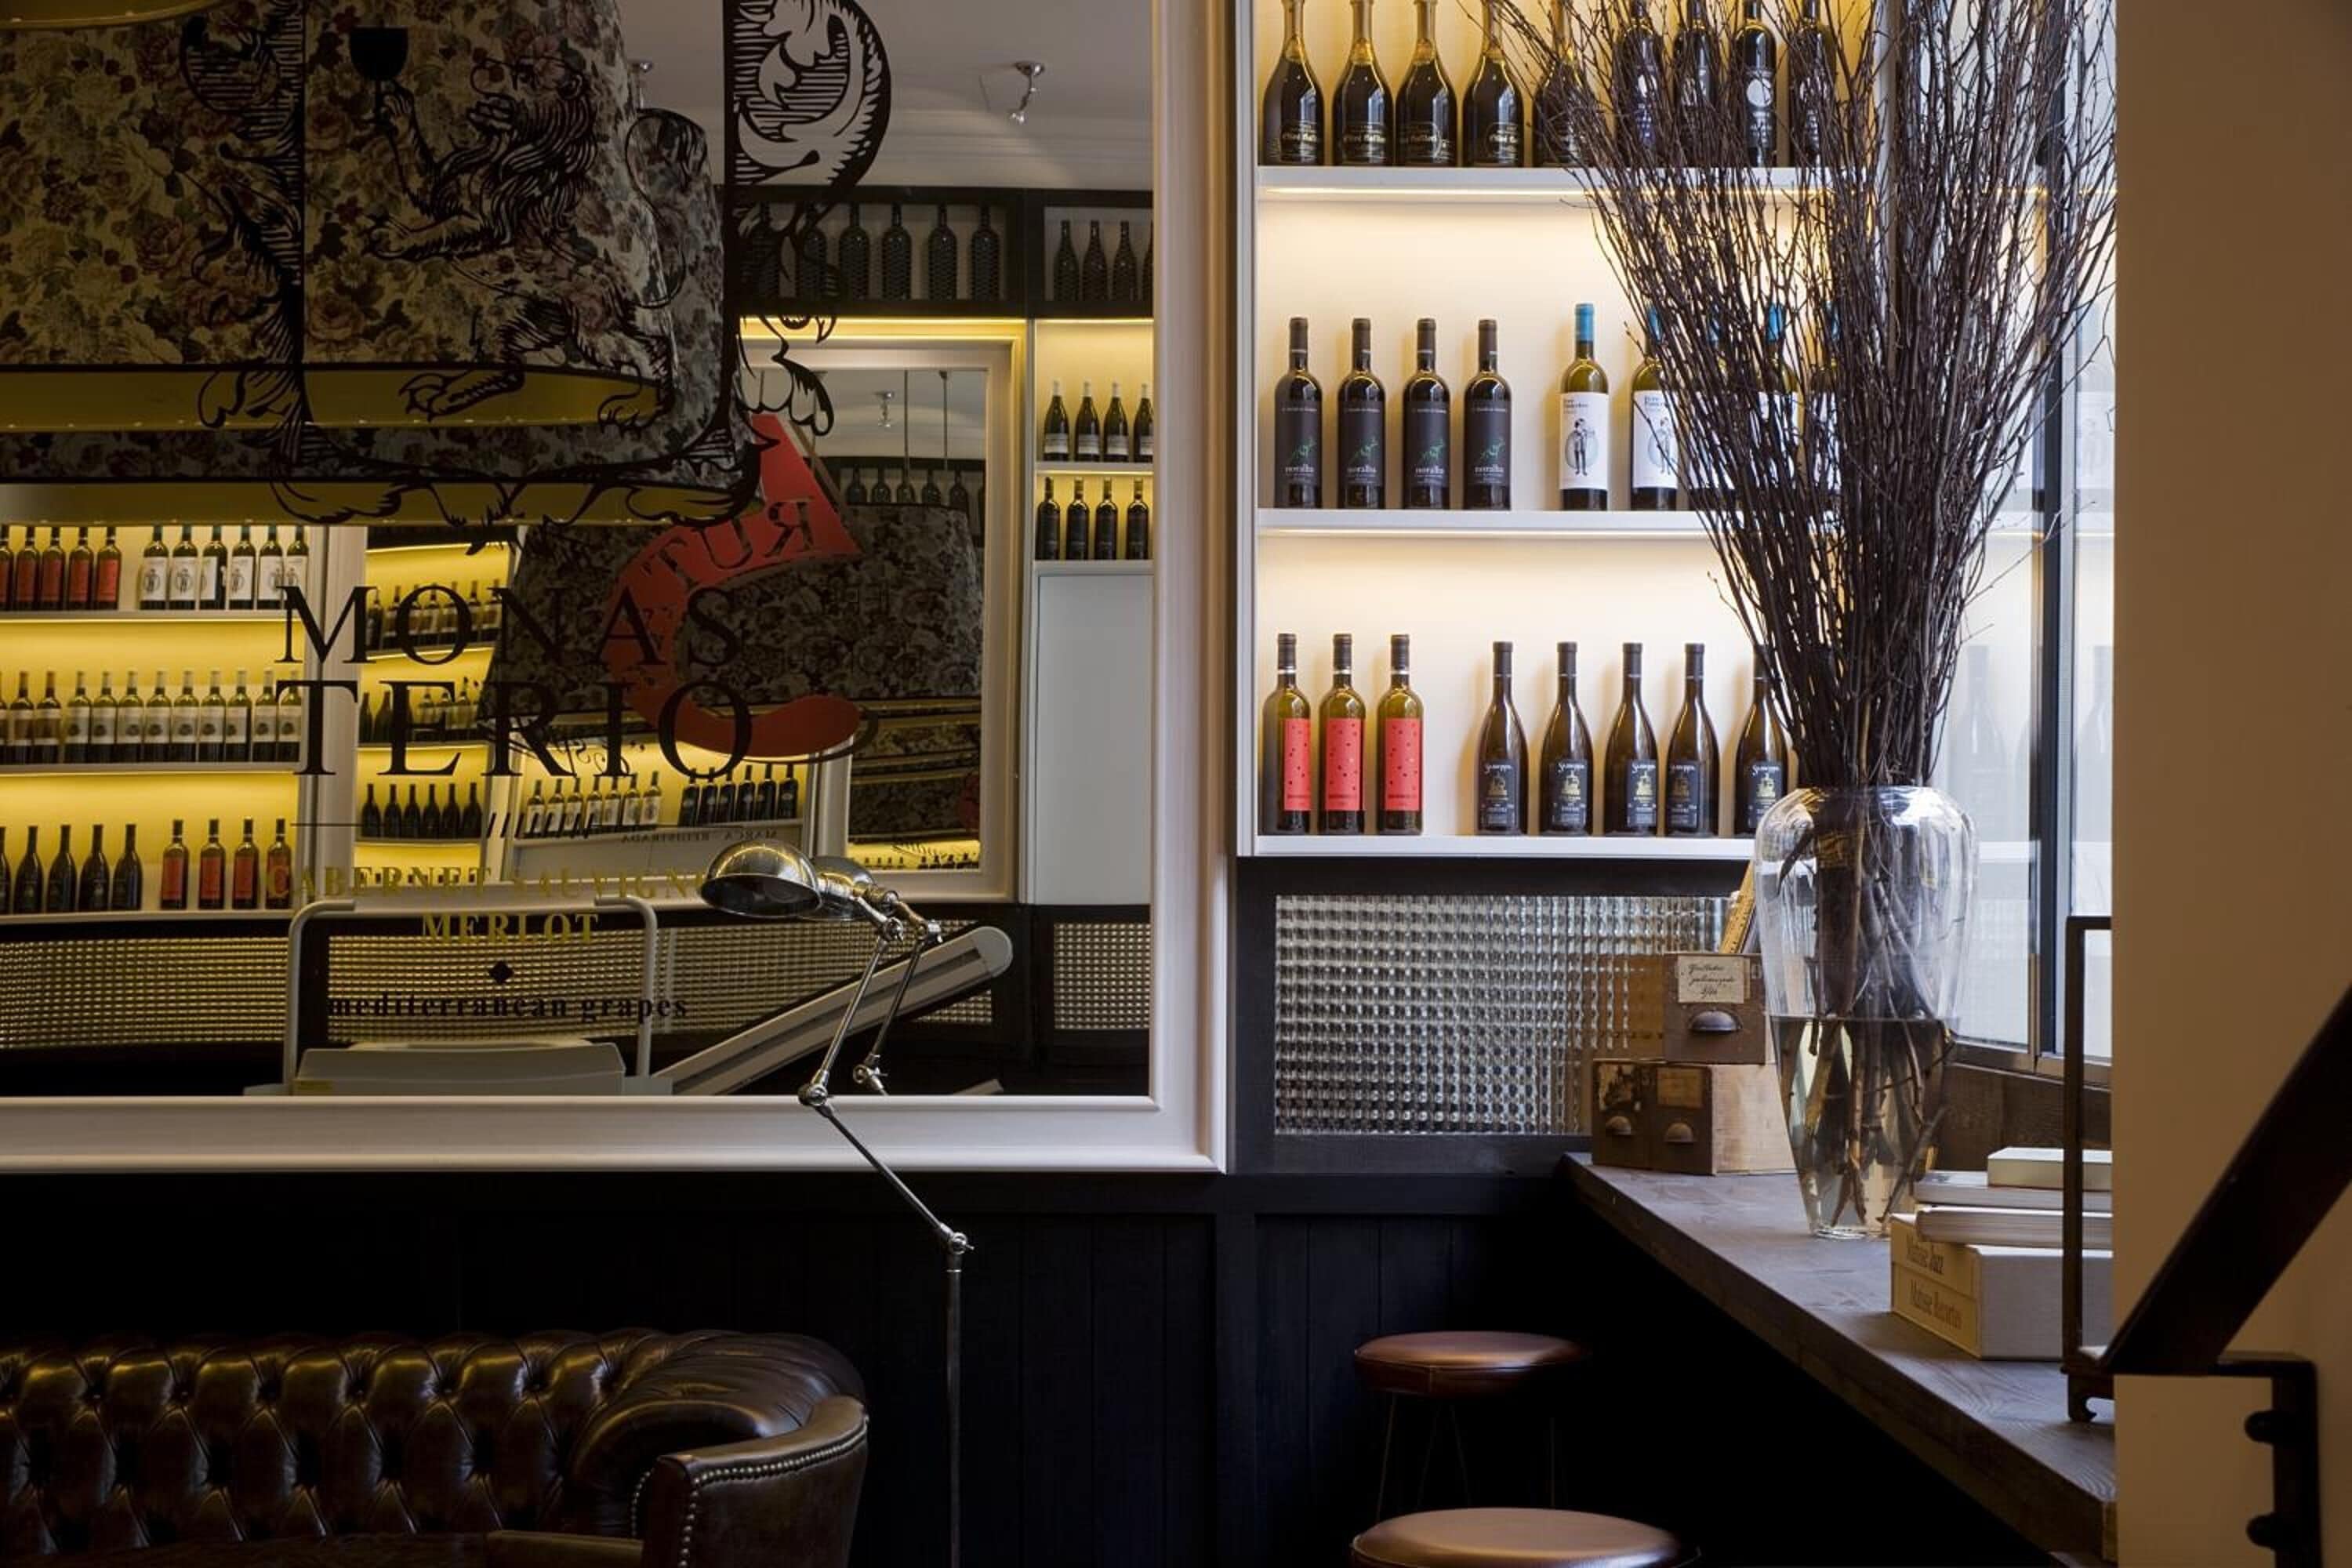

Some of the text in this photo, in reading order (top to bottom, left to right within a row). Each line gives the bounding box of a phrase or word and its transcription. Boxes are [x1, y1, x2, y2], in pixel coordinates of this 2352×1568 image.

[275, 585, 743, 666] MONAS
[276, 679, 753, 780] TERIO
[268, 866, 493, 898] CABERNET
[421, 913, 599, 944] MERLOT
[328, 993, 688, 1024] mediterranean grapes
